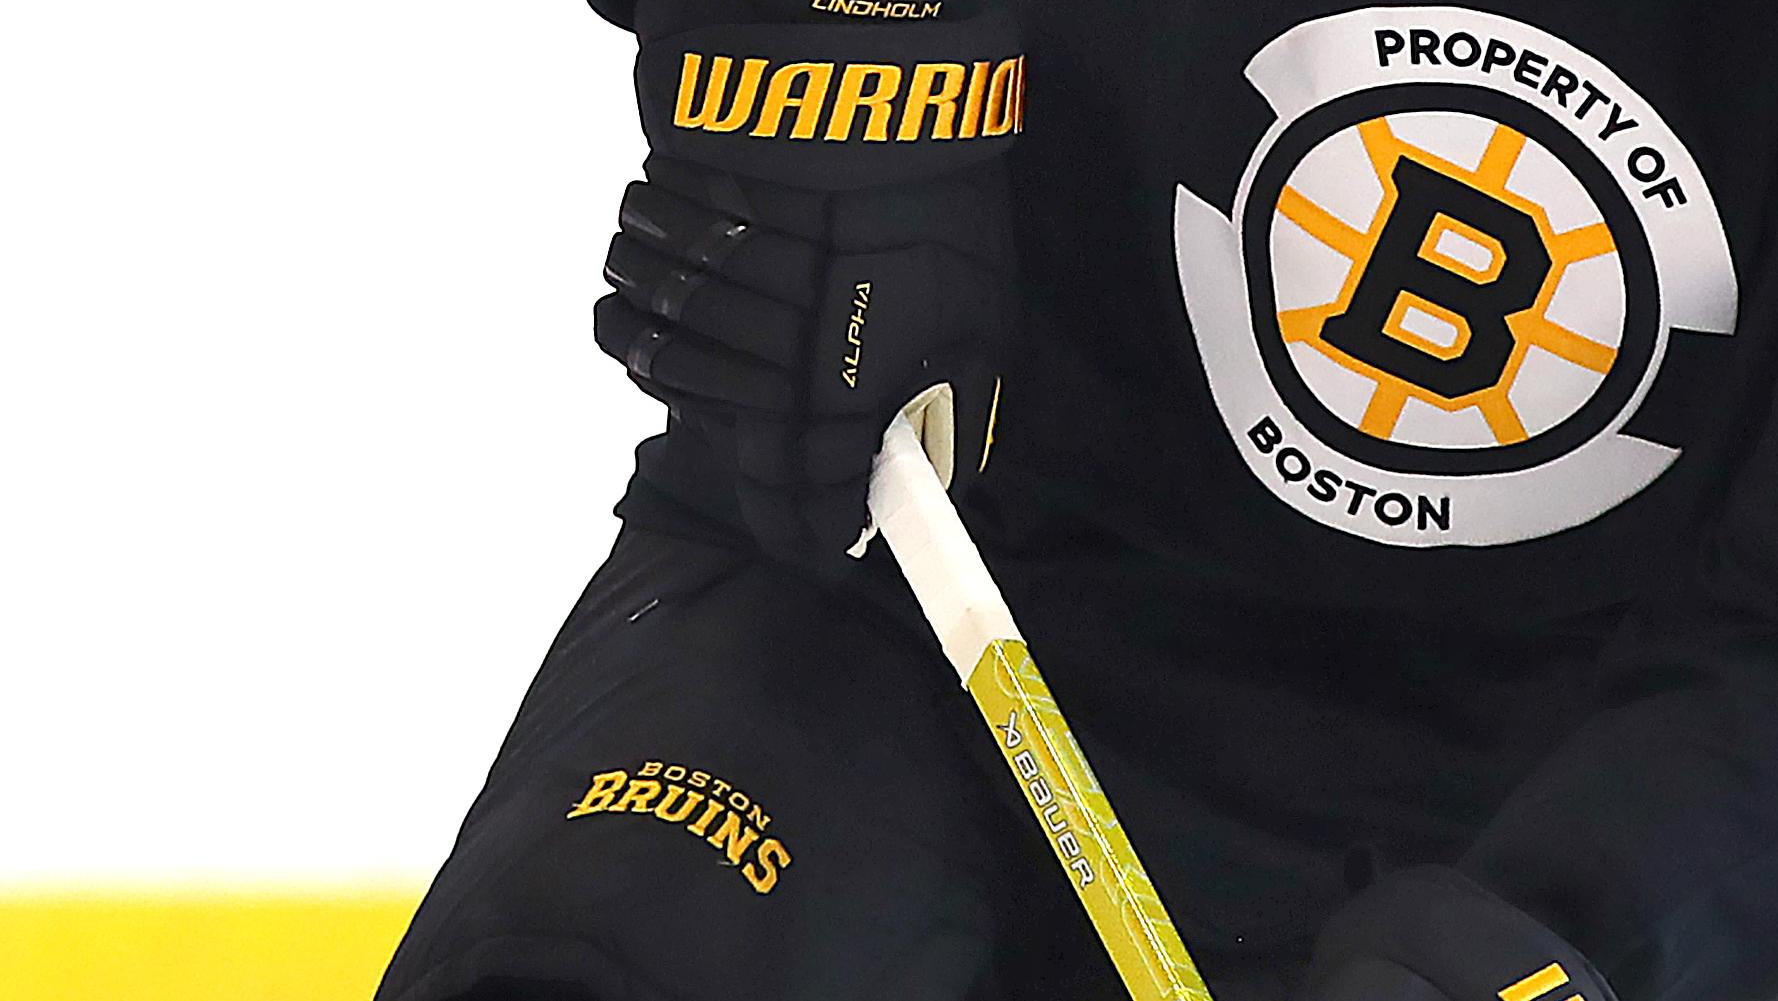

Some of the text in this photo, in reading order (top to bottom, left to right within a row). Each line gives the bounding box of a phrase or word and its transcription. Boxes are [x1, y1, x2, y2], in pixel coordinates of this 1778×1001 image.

[673, 53, 1026, 141] WARRIO
[1374, 29, 1688, 209] PROPERTY OF
[842, 282, 870, 388] ALPHA
[1318, 154, 1555, 400] B
[1246, 416, 1452, 532] BOSTON
[566, 770, 792, 894] BRUINS
[637, 761, 772, 831] BOSTON
